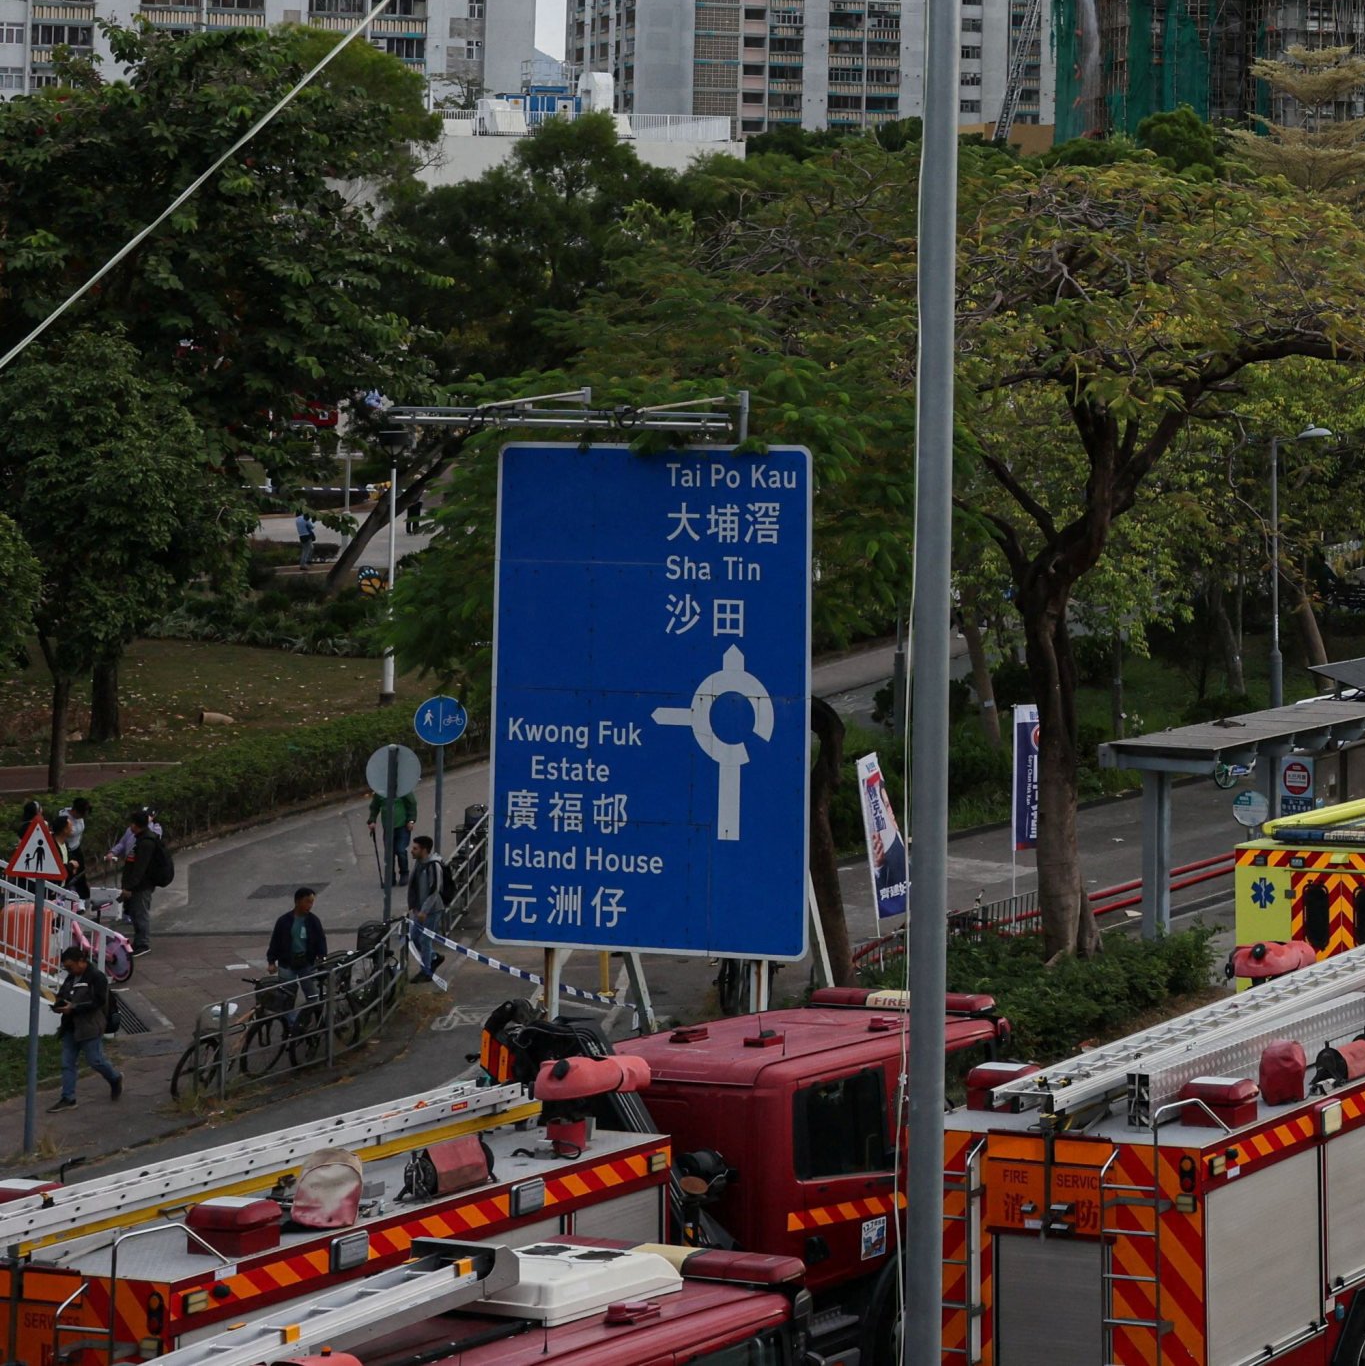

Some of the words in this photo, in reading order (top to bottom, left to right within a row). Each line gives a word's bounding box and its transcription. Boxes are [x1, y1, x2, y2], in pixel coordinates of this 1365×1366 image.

[666, 463, 701, 487] Tai
[710, 464, 740, 489] Po
[751, 465, 797, 489] Kau
[666, 556, 710, 580] Sha
[723, 556, 761, 581] Tin
[666, 594, 745, 638] 沙田
[507, 718, 588, 749] Kwong
[599, 721, 642, 746] Fuk
[531, 756, 609, 782] Estate
[504, 790, 628, 835] 廣福邨
[504, 843, 576, 869] Island
[585, 847, 664, 874] House
[503, 884, 627, 927] 元洲仔
[874, 997, 907, 1007] FIRE
[1003, 1170, 1029, 1185] FIRE
[1075, 1198, 1100, 1231] 防
